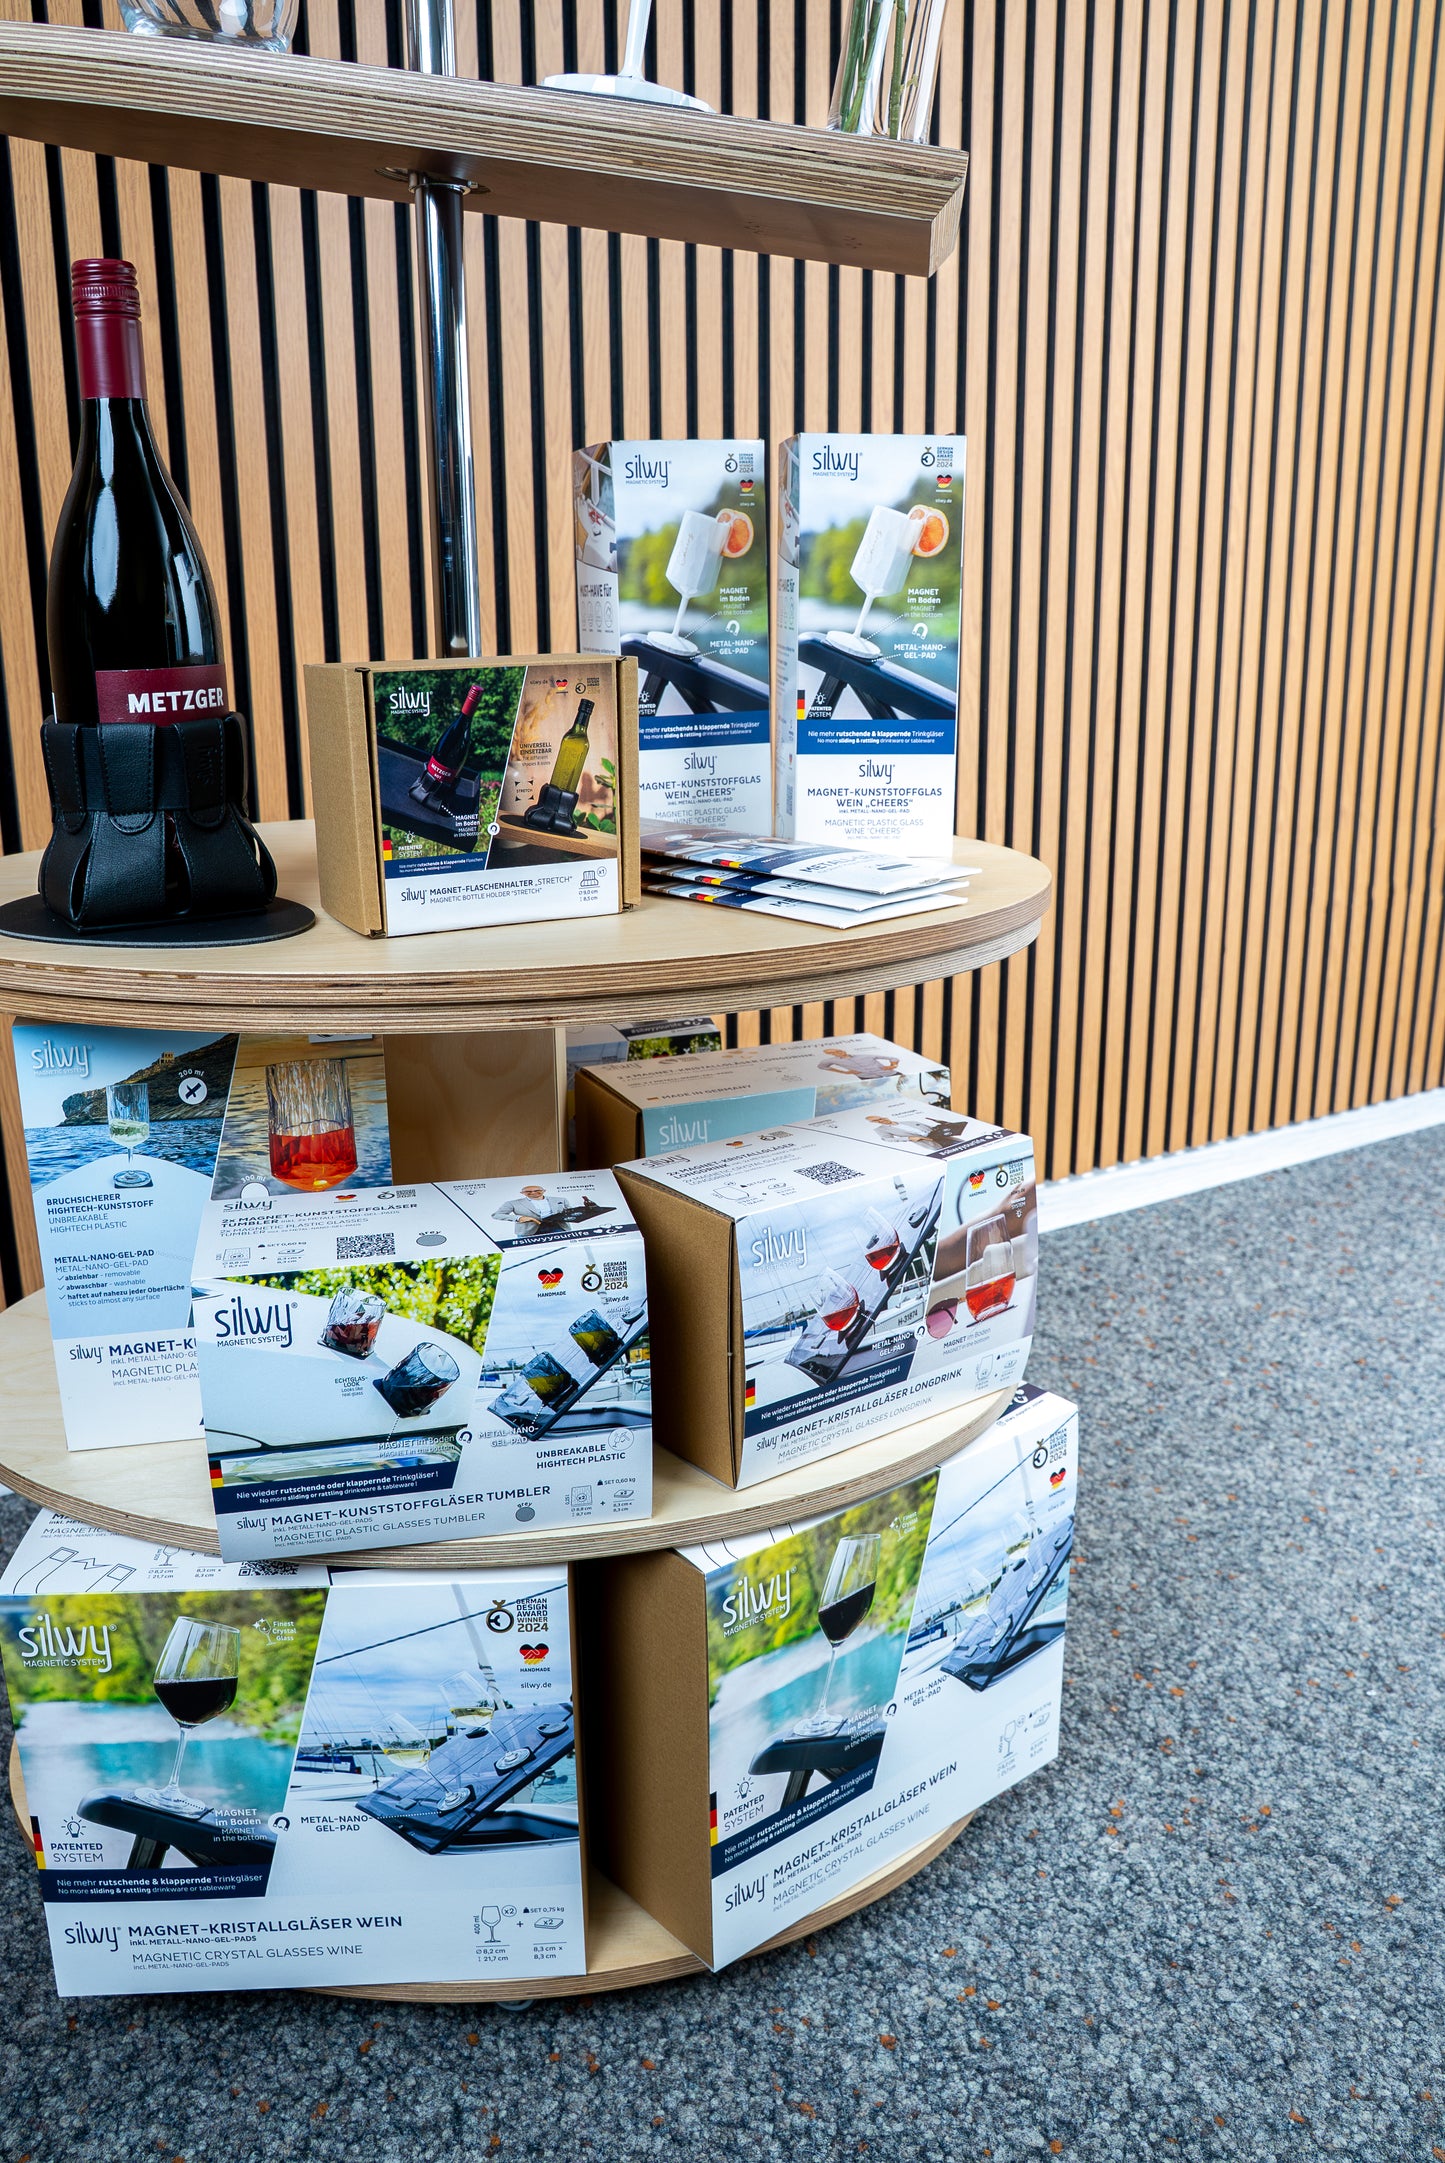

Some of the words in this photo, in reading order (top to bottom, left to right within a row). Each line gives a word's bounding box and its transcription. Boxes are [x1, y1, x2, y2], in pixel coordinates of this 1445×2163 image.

[908, 588, 939, 596] MAGNET
[918, 596, 941, 604] Boden
[710, 639, 758, 648] METAL-NANO-
[894, 643, 946, 651] METAL-NANO-
[719, 647, 749, 655] GEL-PAD
[128, 686, 224, 715] METZGER
[877, 730, 911, 738] klappernde
[912, 730, 944, 738] Trinkgläser
[665, 790, 689, 799] WEIN
[808, 788, 942, 797] MAGNET-KUNSTSTOFFGLAS
[837, 799, 862, 807] WEIN
[429, 879, 533, 896] MAGNET-FLASCHENHALTER
[430, 895, 461, 904] MAGNETIC
[463, 893, 485, 901] BOTTLE
[487, 891, 510, 899] HOLDER
[178, 1069, 194, 1078] 200
[46, 1193, 121, 1206] BRUCHSICHERER
[48, 1199, 154, 1215] HIGHTECH-KUNSTSTOFF
[48, 1213, 108, 1224] UNBREAKABLE
[50, 1223, 93, 1233] HIGHTECH
[94, 1221, 127, 1230] PLASTIC
[512, 1230, 589, 1246] #silwyyourlife
[55, 1259, 148, 1273] METAL-NANO-GEL-PAD
[65, 1272, 98, 1280] abziehbar
[66, 1281, 108, 1290] abwaschbar
[129, 1288, 146, 1296] jeder
[147, 1284, 185, 1293] Oberfläche
[604, 1282, 628, 1290] 2024
[537, 1290, 566, 1298] HANDMADE
[897, 1310, 918, 1326] H-31874
[217, 1338, 255, 1347] MAGNETIC
[257, 1335, 287, 1344] SYSTEM
[871, 1332, 913, 1351] METAL-NANO-
[879, 1343, 905, 1356] GEL-PAD
[781, 1388, 909, 1441] MAGNET-KRISTALLGLÄSER
[910, 1368, 962, 1398] LONGDRINK
[777, 1438, 821, 1460] MAGNETIC
[821, 1425, 855, 1445] CRYSTAL
[854, 1414, 888, 1431] GLASSES
[888, 1398, 932, 1418] LONGDRINK
[536, 1444, 606, 1459] UNBREAKABLE
[536, 1457, 585, 1468] HIGHTECH
[588, 1452, 626, 1463] PLASTIC
[251, 1489, 279, 1497] wieder
[280, 1484, 324, 1495] rutschende
[327, 1482, 345, 1490] oder
[346, 1476, 391, 1489] klappernde
[393, 1471, 433, 1483] Trinkgläser
[272, 1493, 484, 1525] MAGNET-KUNSTSTOFFGLÄSER
[487, 1486, 550, 1501] TUMBLER
[274, 1530, 333, 1542] MAGNETIC
[335, 1525, 380, 1536] PLASTIC
[382, 1521, 432, 1532] GLASSES
[434, 1512, 485, 1523] TUMBLER
[723, 1617, 758, 1638] MAGNETIC
[760, 1604, 786, 1621] SYSTEM
[517, 1623, 548, 1632] 2024
[23, 1659, 68, 1667] MAGNETIC
[71, 1658, 105, 1666] SYSTEM
[521, 1681, 552, 1689] silwy.de
[904, 1678, 950, 1703] METAL-NANO-
[912, 1687, 942, 1706] GEL-PAD
[215, 1809, 257, 1817] MAGNET
[723, 1794, 765, 1820] PATENTED
[229, 1817, 261, 1825] Boden
[724, 1804, 764, 1832] SYSTEM
[773, 1782, 926, 1879] MAGNET-KRISTALLGLÄSER
[929, 1762, 958, 1786] WEIN
[316, 1824, 360, 1832] GEL-PAD
[51, 1842, 103, 1851] PATENTED
[53, 1852, 103, 1862] SYSTEM
[773, 1869, 824, 1904] MAGNETIC
[824, 1846, 865, 1873] CRYSTAL
[866, 1820, 907, 1848] GLASSES
[906, 1804, 930, 1824] WINE
[74, 1878, 96, 1886] mehr
[98, 1878, 150, 1886] rutschende
[160, 1876, 212, 1886] klappernde
[213, 1874, 262, 1884] Trinkgläser
[128, 1916, 352, 1936] MAGNET-KRISTALLGLÄSER
[356, 1916, 402, 1928] WEIN
[149, 1935, 256, 1945] METALL-NANO-GEL-PADS
[132, 1952, 201, 1963] MAGNETIC
[204, 1950, 263, 1960] CRYSTAL
[266, 1946, 324, 1958] GLASSES
[327, 1945, 363, 1955] WINE
